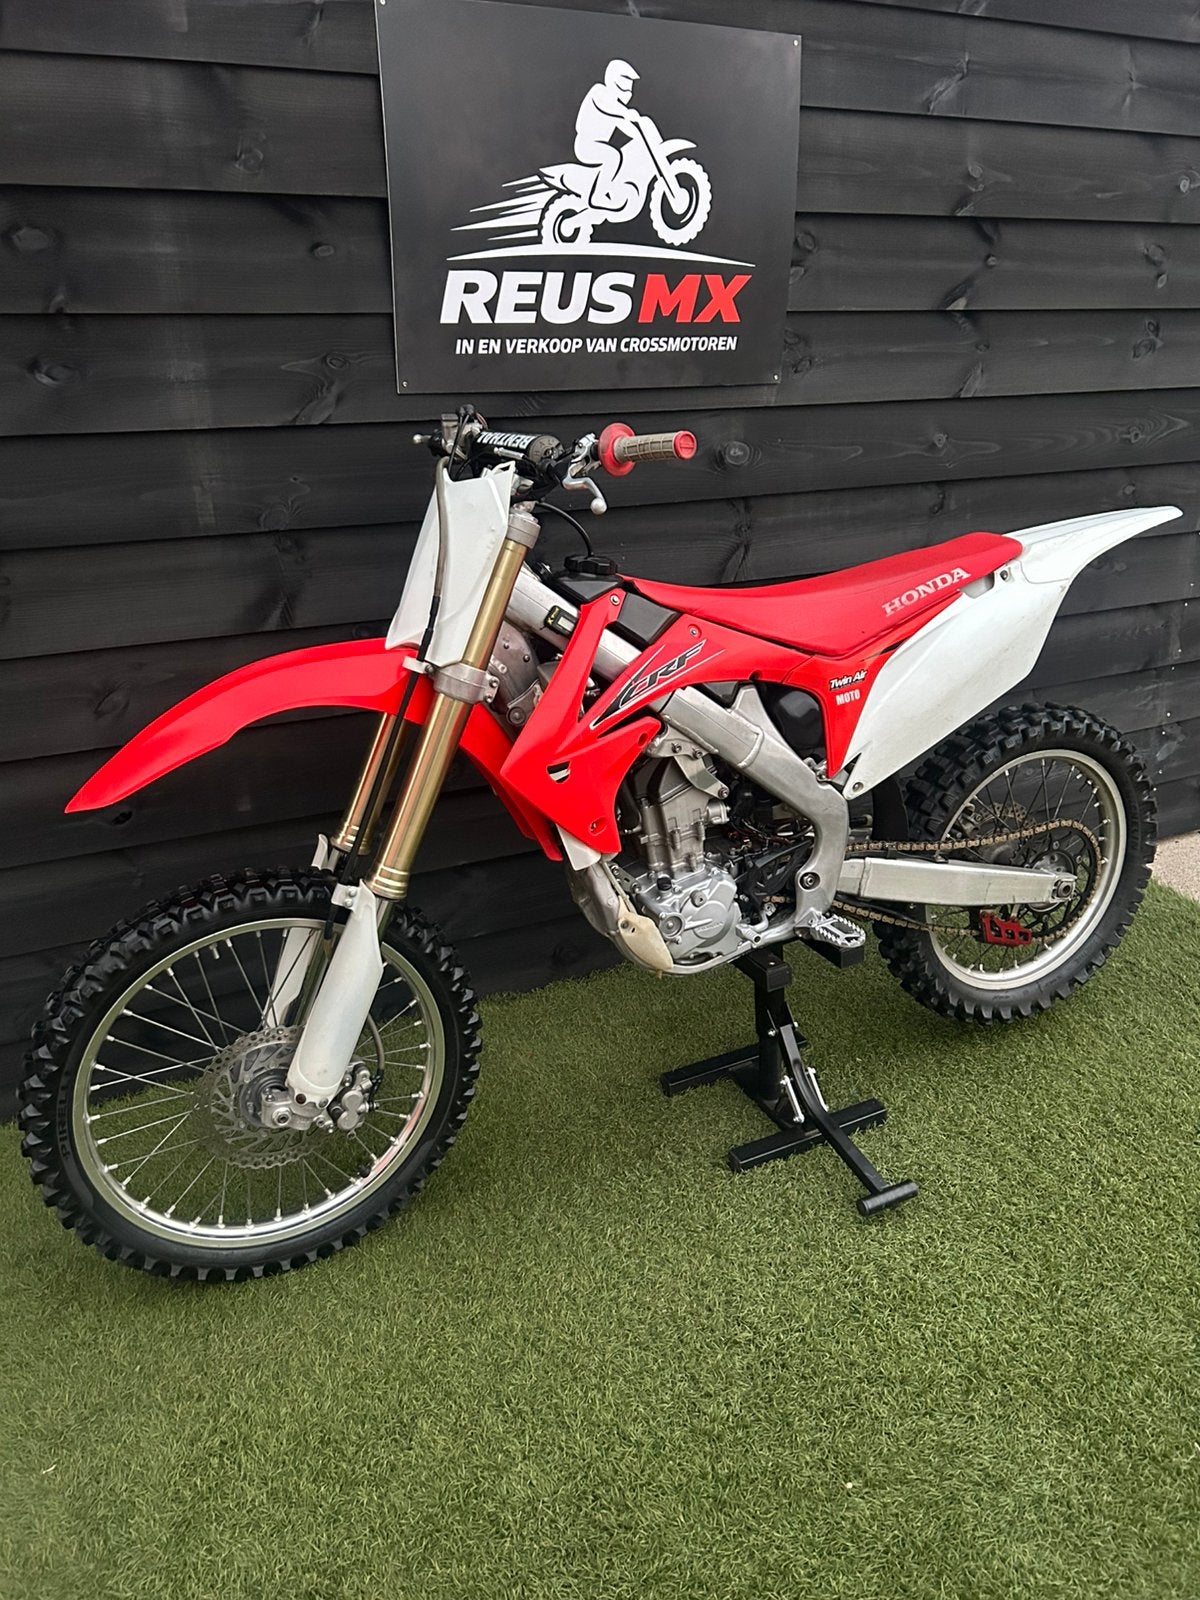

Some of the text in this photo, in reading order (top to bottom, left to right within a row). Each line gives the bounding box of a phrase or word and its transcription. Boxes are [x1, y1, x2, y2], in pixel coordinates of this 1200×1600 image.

[439, 269, 753, 325] REUS MX
[455, 336, 738, 354] IN EN VERKOOP VAN CROSSMOTOREN
[476, 431, 537, 449] RENTHAL
[881, 567, 971, 617] HONDA
[618, 638, 707, 709] CRF
[829, 670, 867, 689] Twin Air
[835, 689, 861, 705] MOTO
